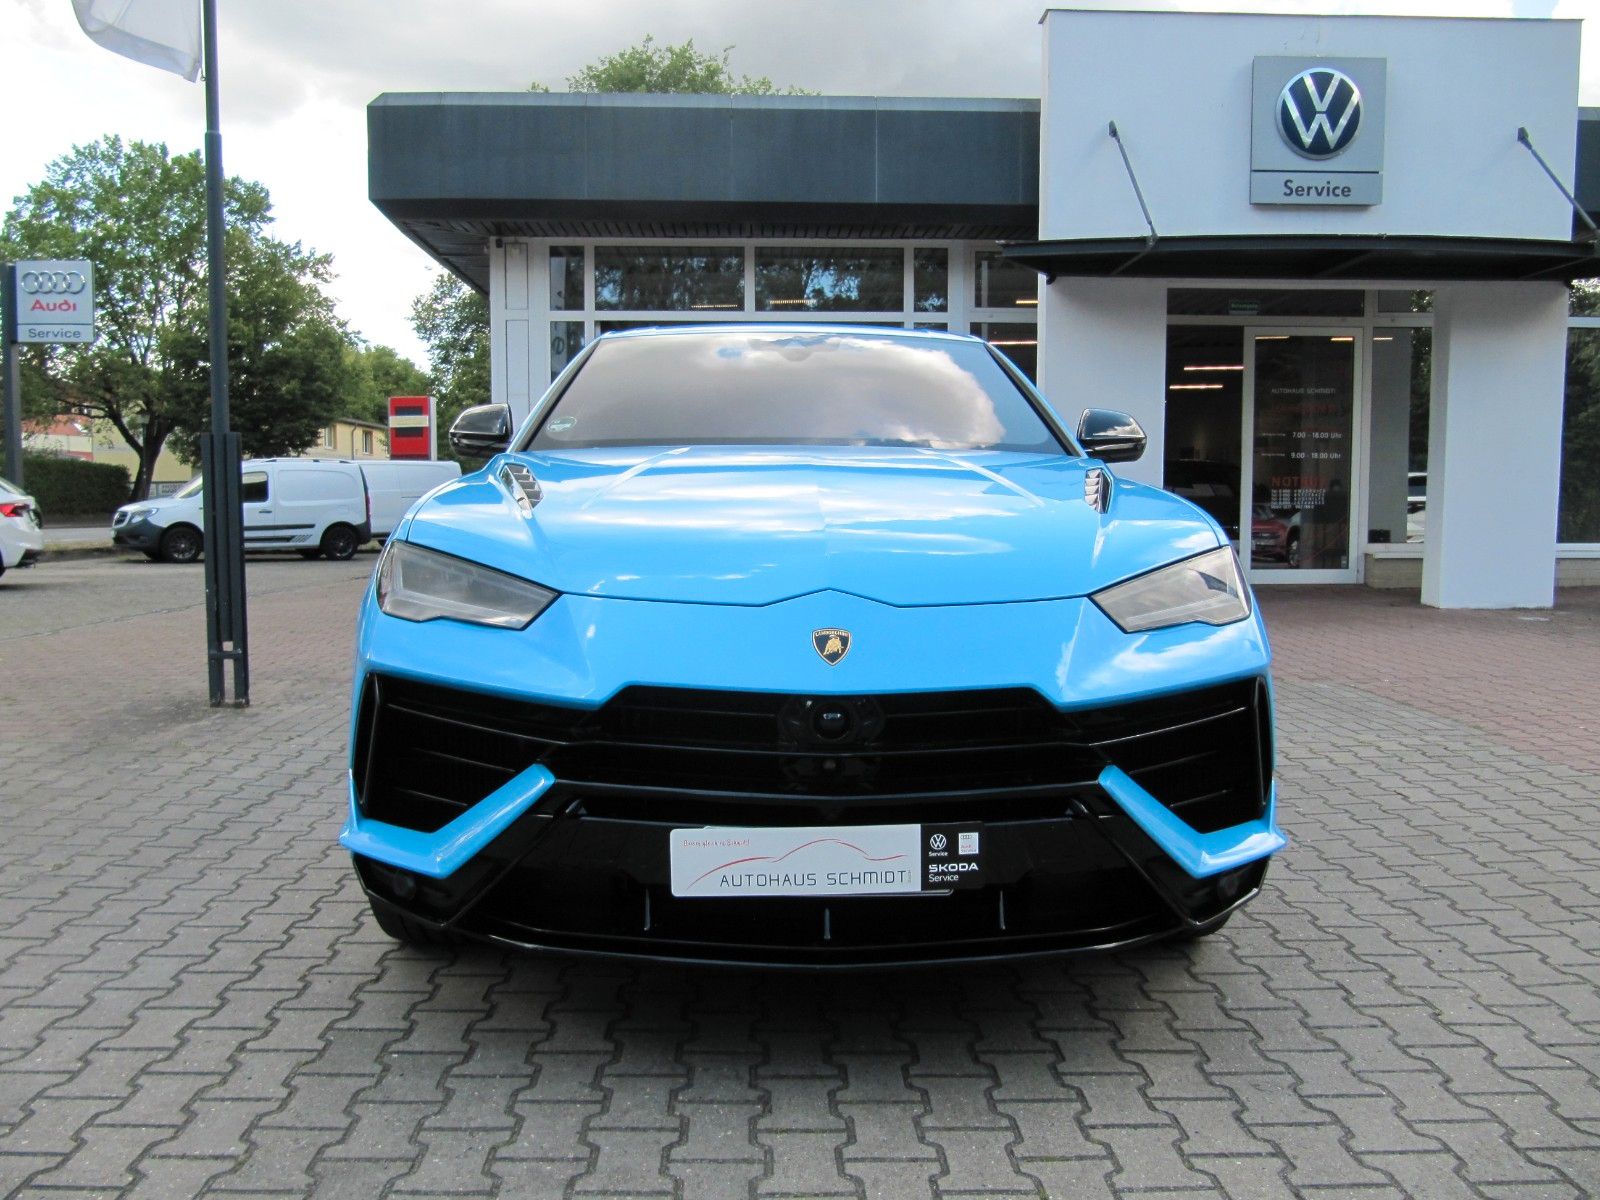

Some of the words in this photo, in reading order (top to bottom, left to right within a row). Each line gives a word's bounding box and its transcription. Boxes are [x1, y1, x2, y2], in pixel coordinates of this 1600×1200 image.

[1279, 69, 1362, 152] VW
[1283, 179, 1352, 197] Service
[31, 299, 77, 312] Audi
[28, 328, 81, 338] Service
[929, 833, 947, 850] VW
[720, 872, 817, 887] AUTOHAUS
[826, 870, 907, 886] SCHMIDT
[928, 873, 959, 882] Service
